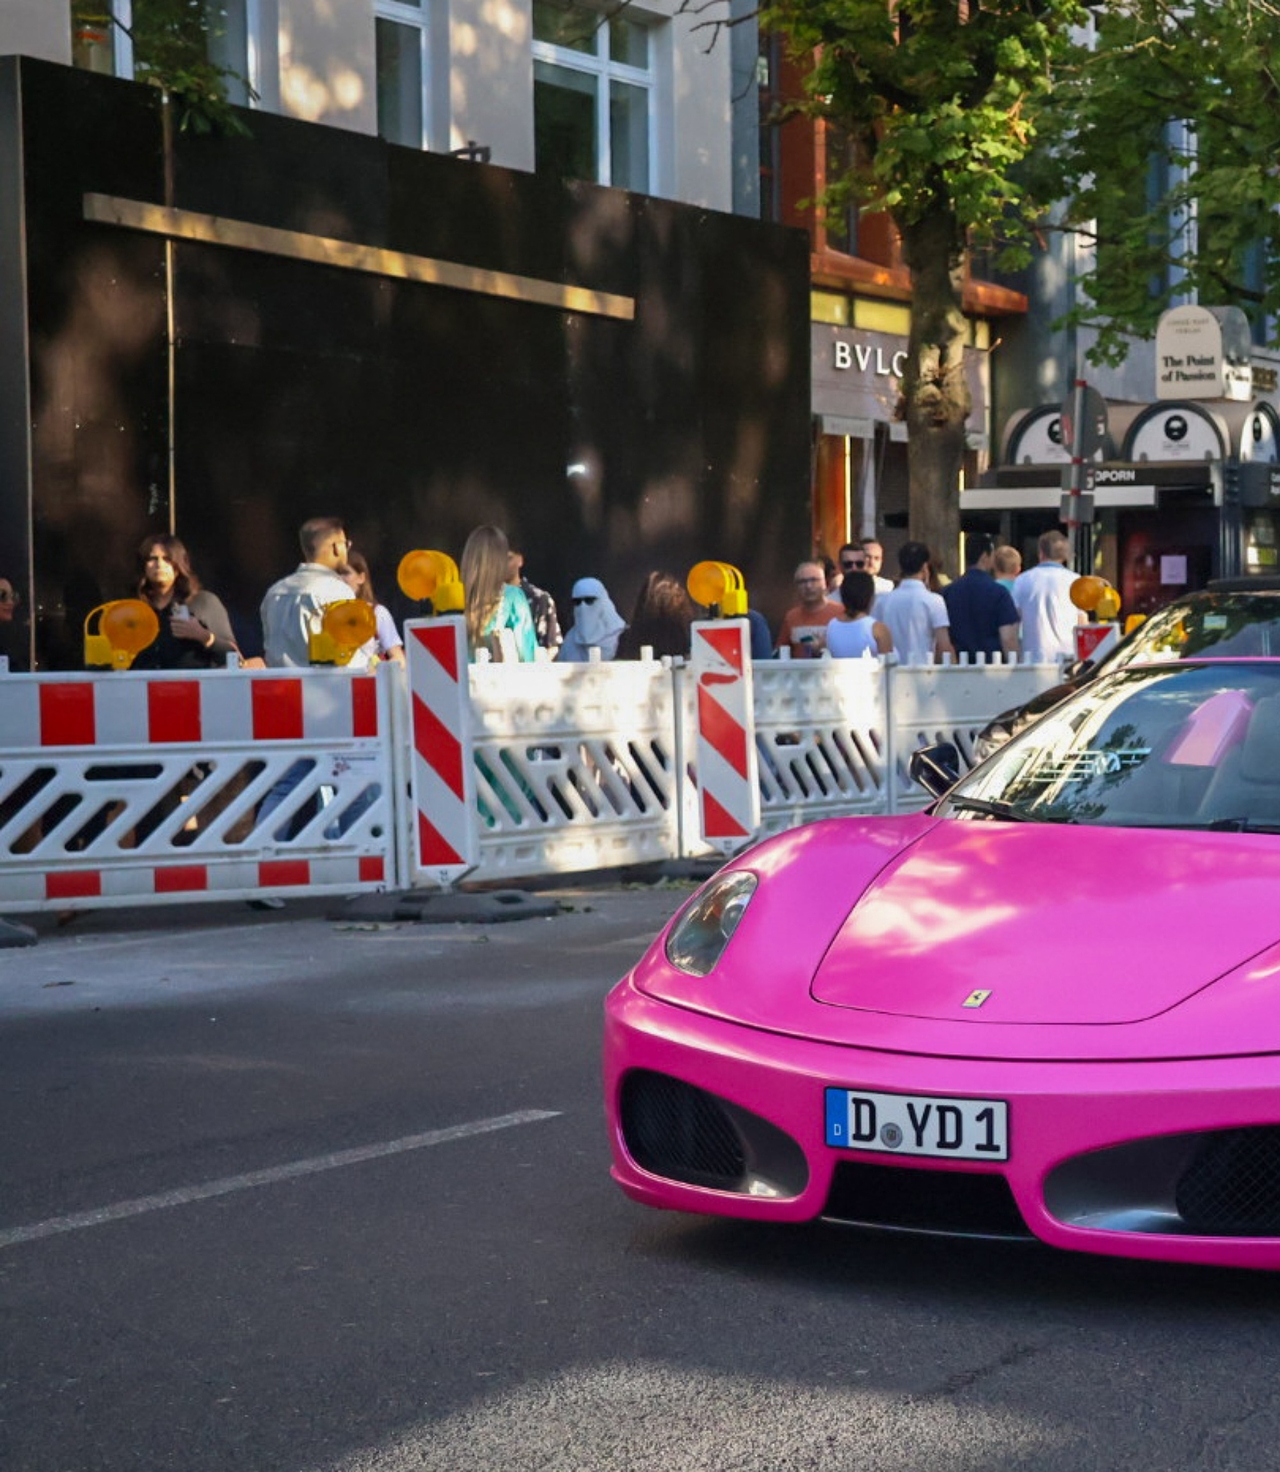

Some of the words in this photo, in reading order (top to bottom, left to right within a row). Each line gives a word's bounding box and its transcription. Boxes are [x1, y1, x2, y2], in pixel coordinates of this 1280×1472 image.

[1162, 355, 1183, 367] The
[1186, 354, 1214, 366] Point
[1161, 370, 1173, 382] of
[851, 1097, 876, 1142] D
